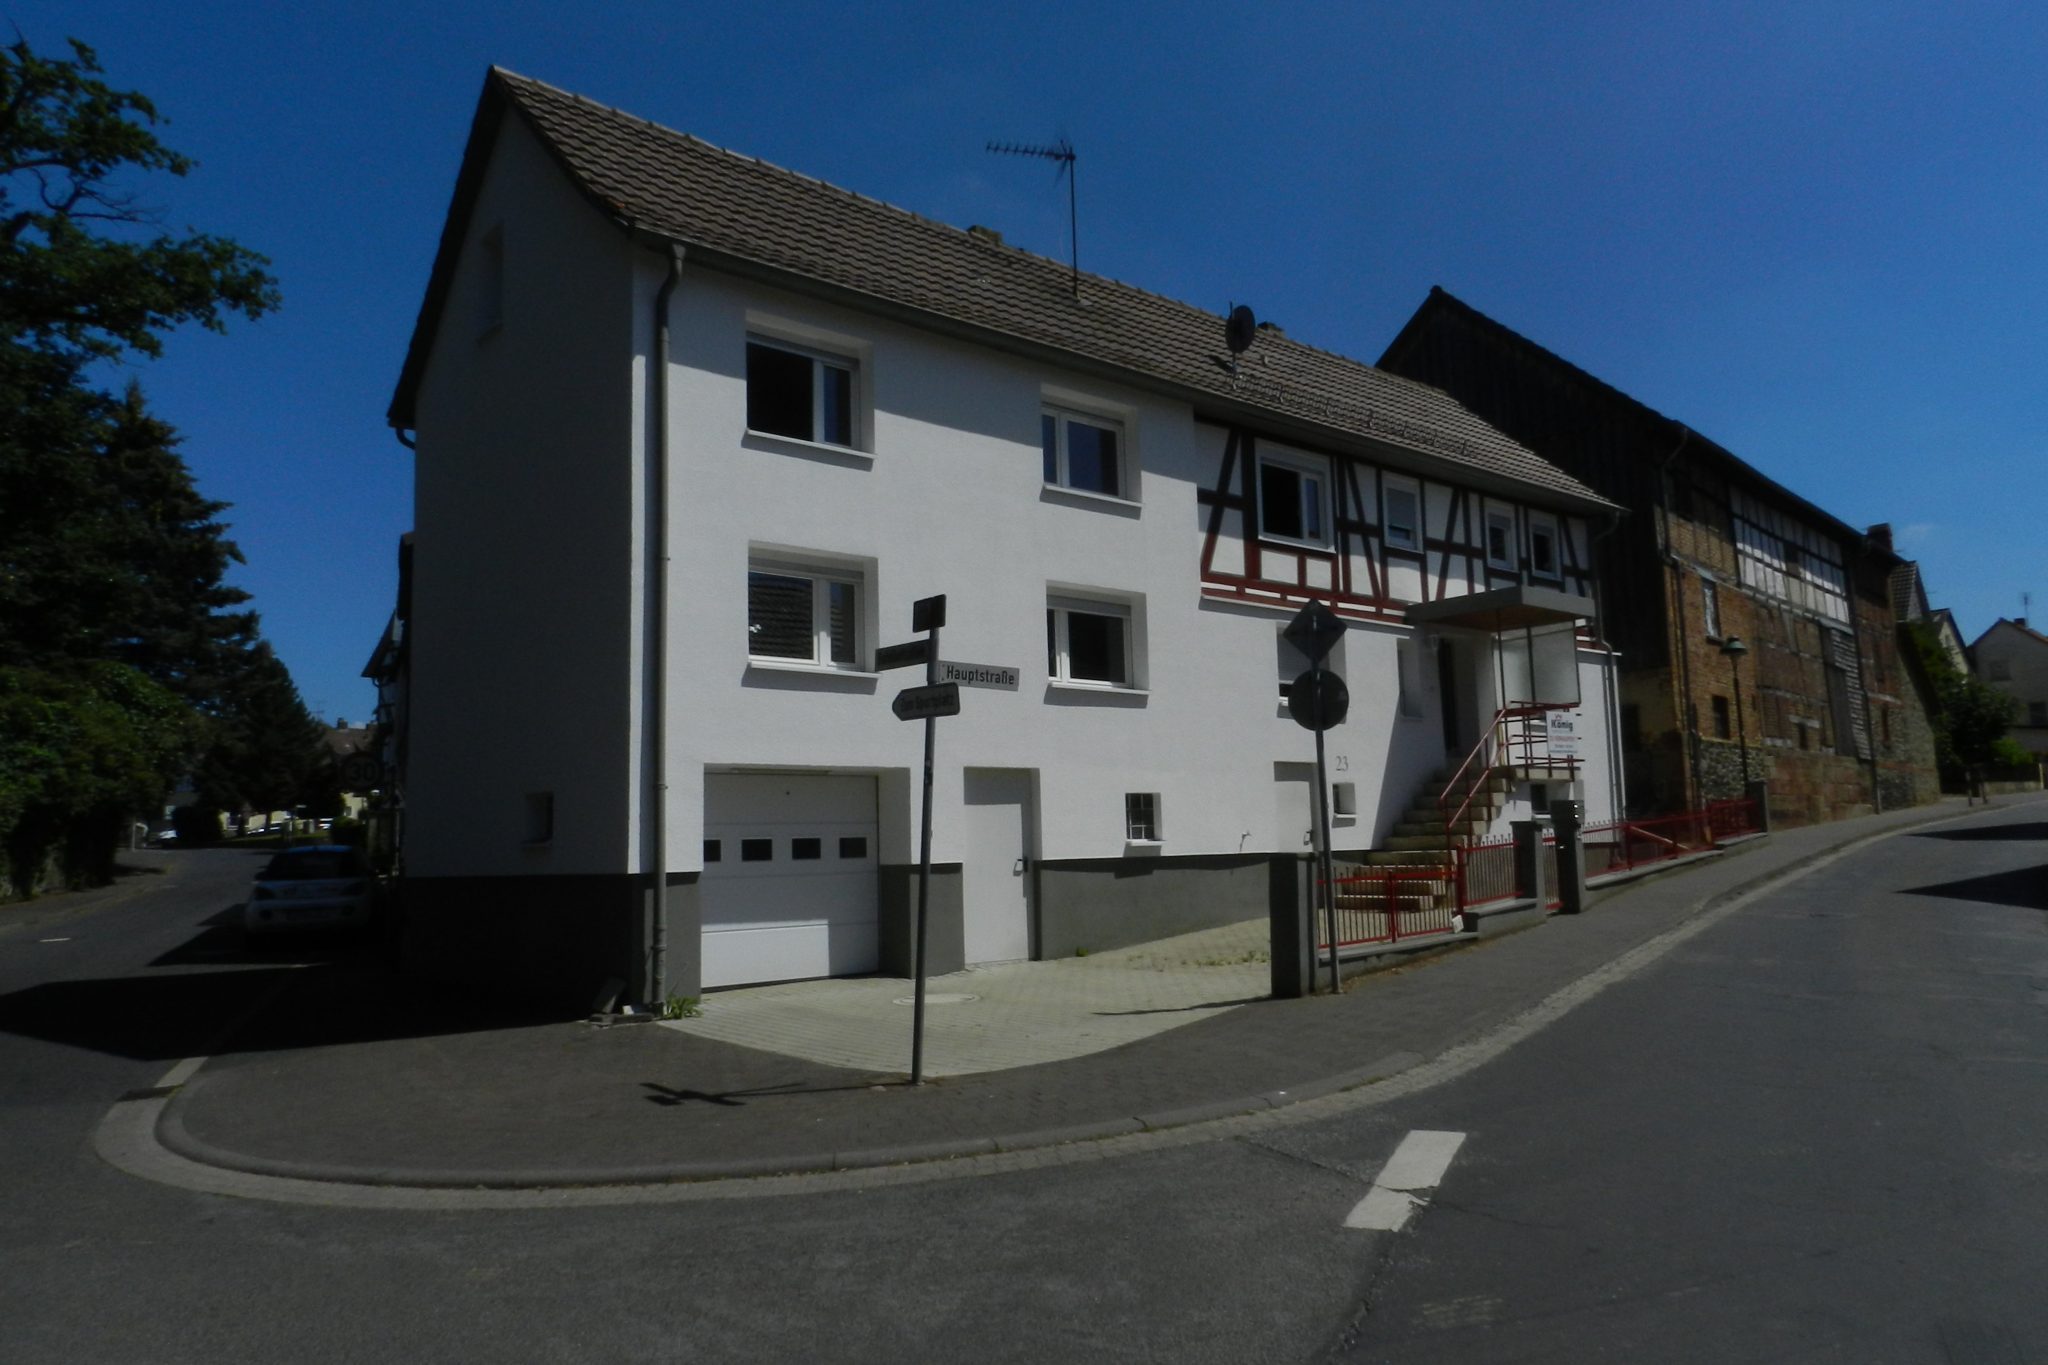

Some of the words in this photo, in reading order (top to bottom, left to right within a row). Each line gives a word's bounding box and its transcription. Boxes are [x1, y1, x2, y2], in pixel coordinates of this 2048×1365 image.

[946, 664, 1015, 685] Hauptstraße
[1551, 719, 1574, 733] König
[349, 762, 376, 782] 30
[1336, 755, 1349, 772] 23
